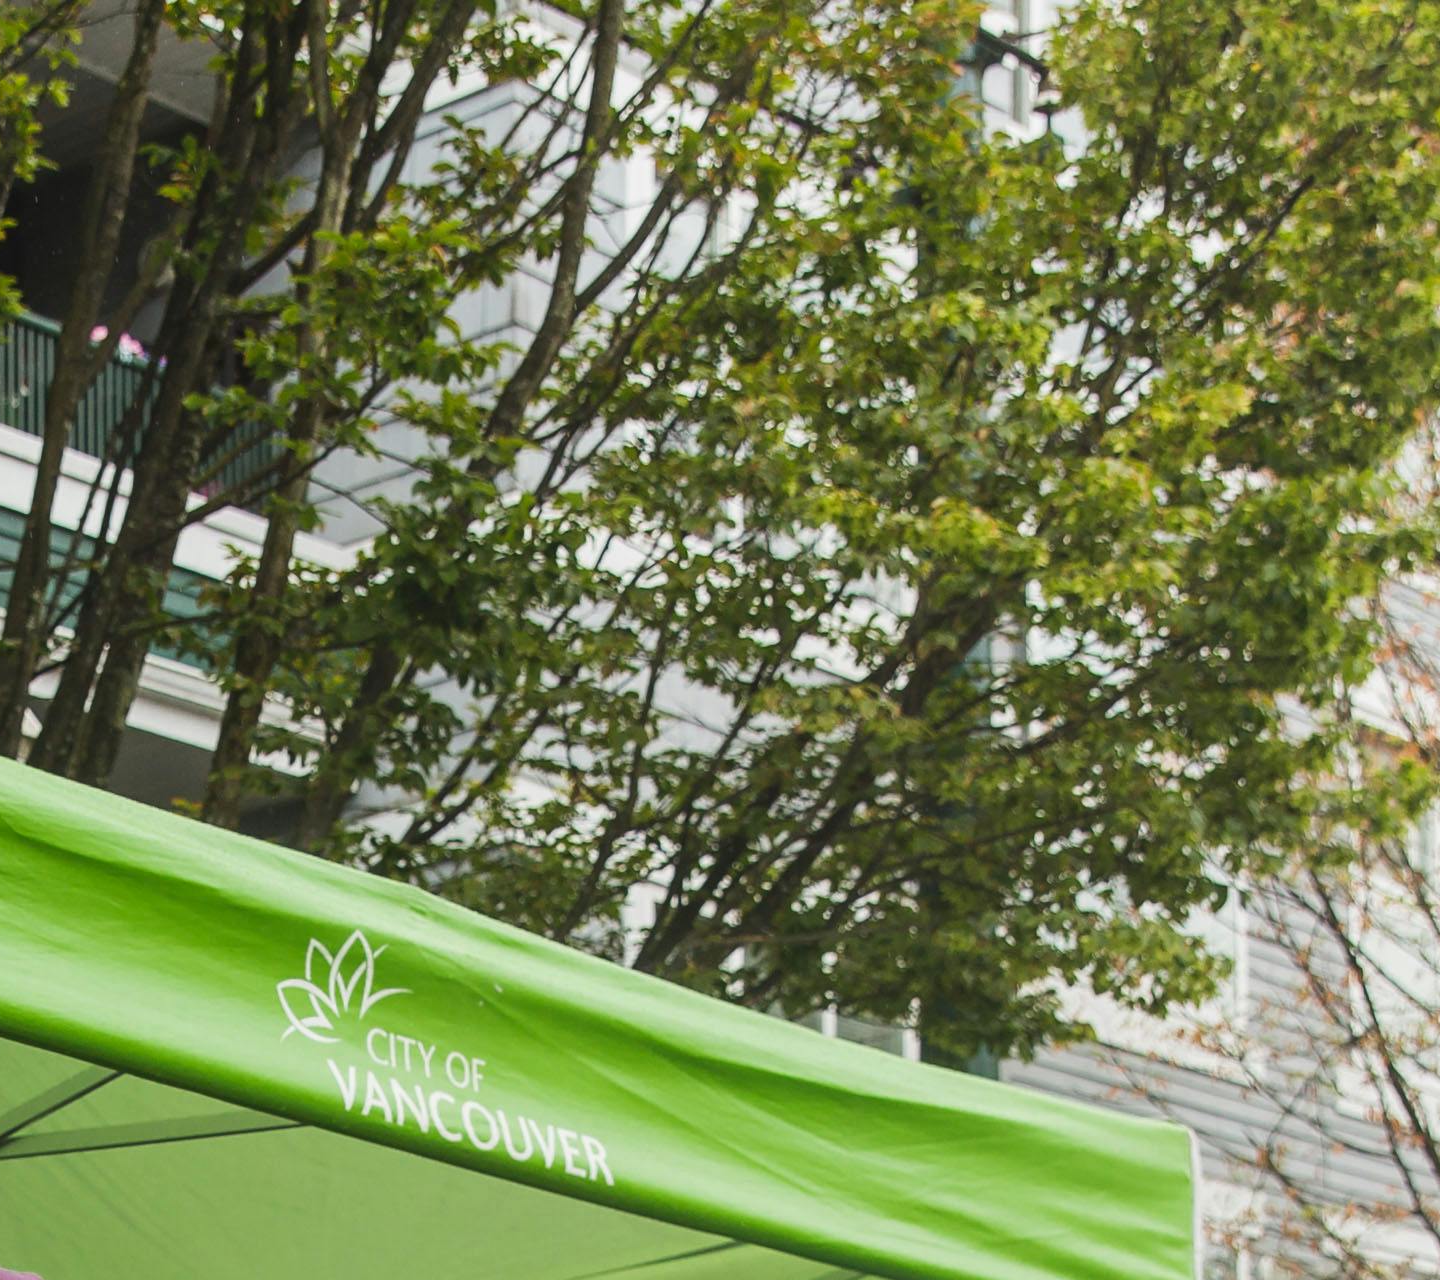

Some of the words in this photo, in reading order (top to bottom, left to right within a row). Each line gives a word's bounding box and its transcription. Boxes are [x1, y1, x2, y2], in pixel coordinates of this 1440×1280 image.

[366, 1028, 437, 1078] CITY
[445, 1052, 487, 1091] OF
[327, 1059, 615, 1186] VANCOUVER
